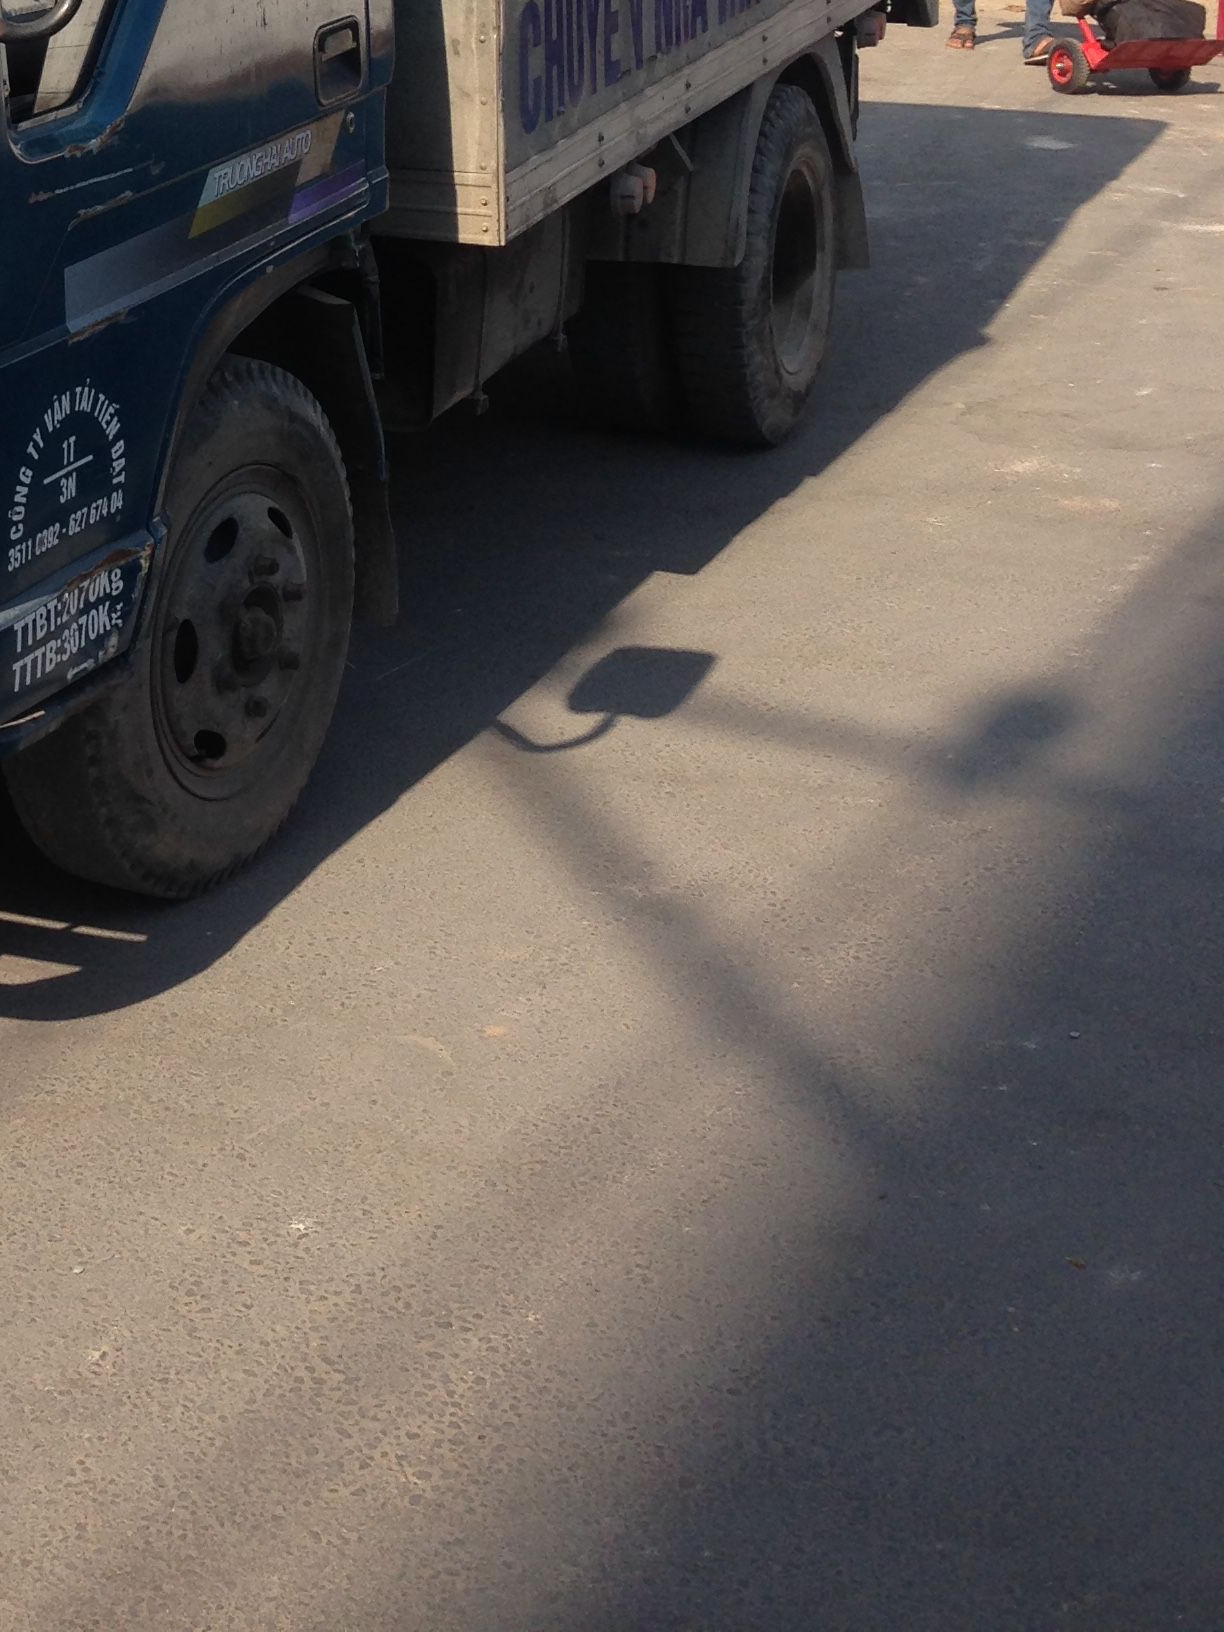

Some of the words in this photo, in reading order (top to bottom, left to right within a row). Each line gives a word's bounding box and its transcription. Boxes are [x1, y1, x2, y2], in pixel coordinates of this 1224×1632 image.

[7, 466, 34, 541] CÔNG
[26, 427, 44, 460] TY
[43, 390, 71, 433] VẬN
[75, 377, 96, 413] TẢI
[110, 439, 126, 485] ĐẠT
[62, 435, 77, 466] 1T
[59, 471, 77, 504] 3N
[7, 536, 33, 573] 3511
[68, 506, 88, 536] 627
[89, 496, 108, 525] 674
[110, 488, 123, 514] 04
